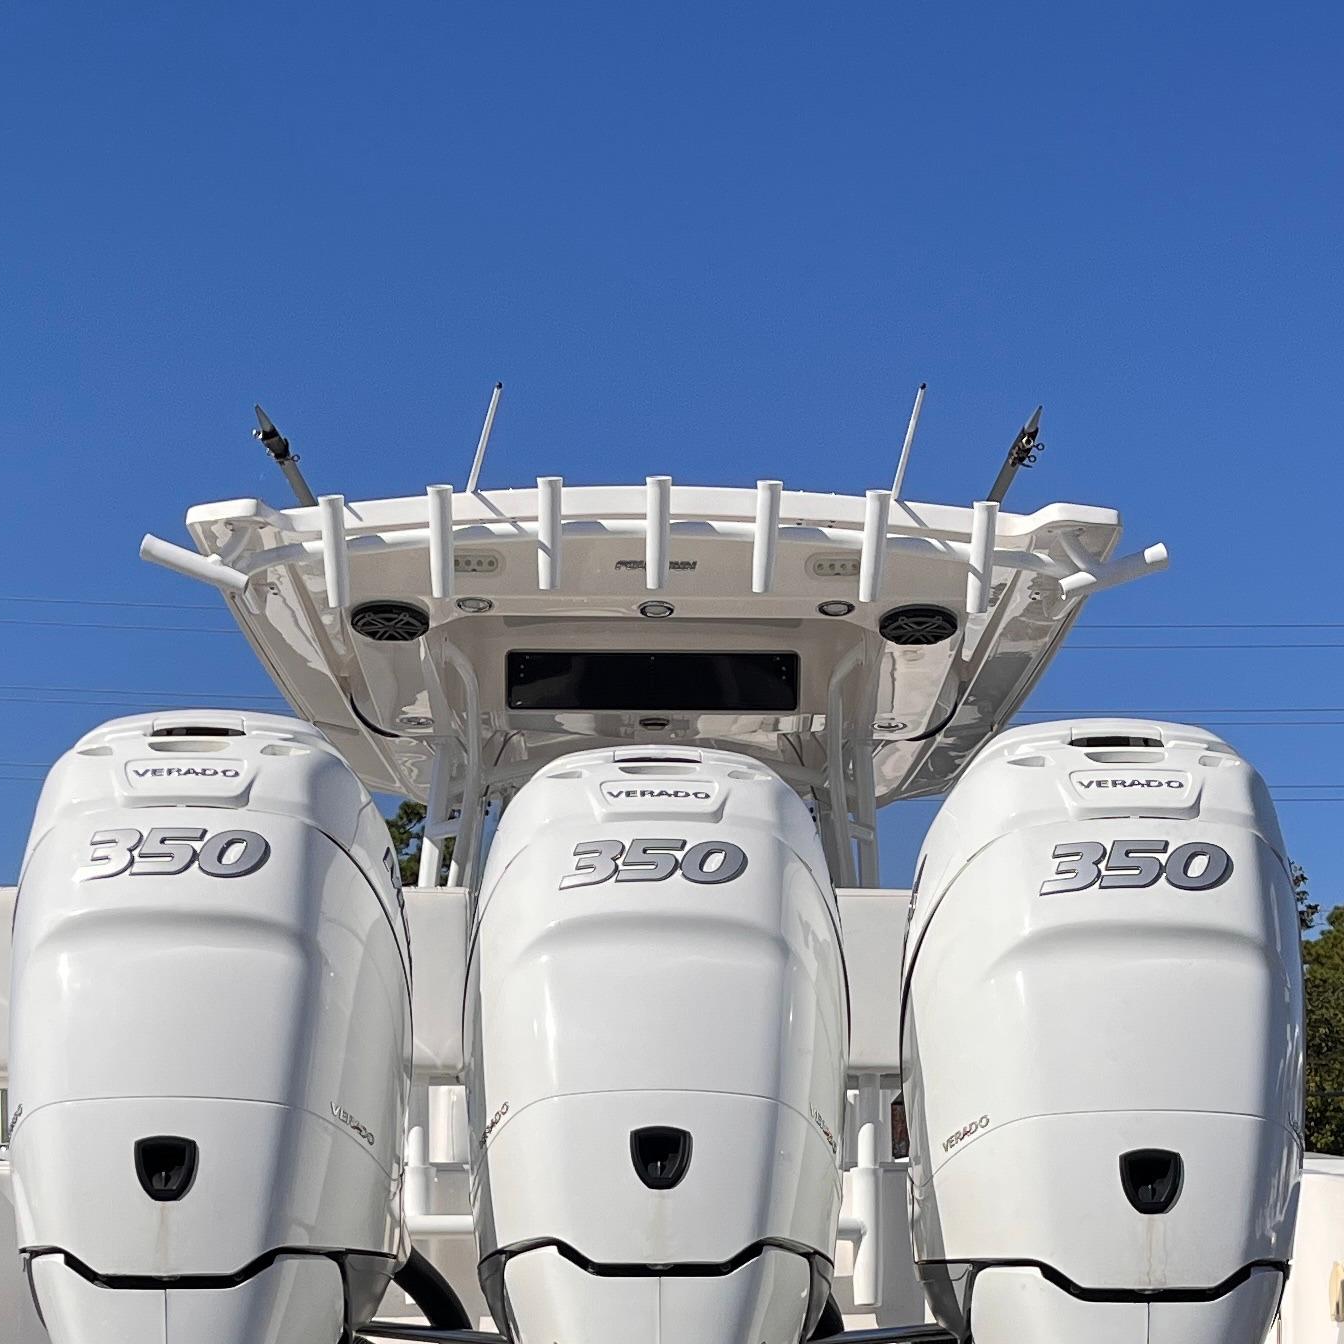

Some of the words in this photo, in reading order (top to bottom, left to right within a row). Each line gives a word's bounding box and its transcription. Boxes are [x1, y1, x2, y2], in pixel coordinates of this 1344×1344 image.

[132, 767, 241, 779] VERADO
[1077, 778, 1185, 790] VERADO
[606, 789, 711, 800] VERADO
[72, 827, 272, 883] 350
[558, 838, 749, 891] 350
[1039, 839, 1235, 897] 350
[942, 1114, 990, 1152] VERADO
